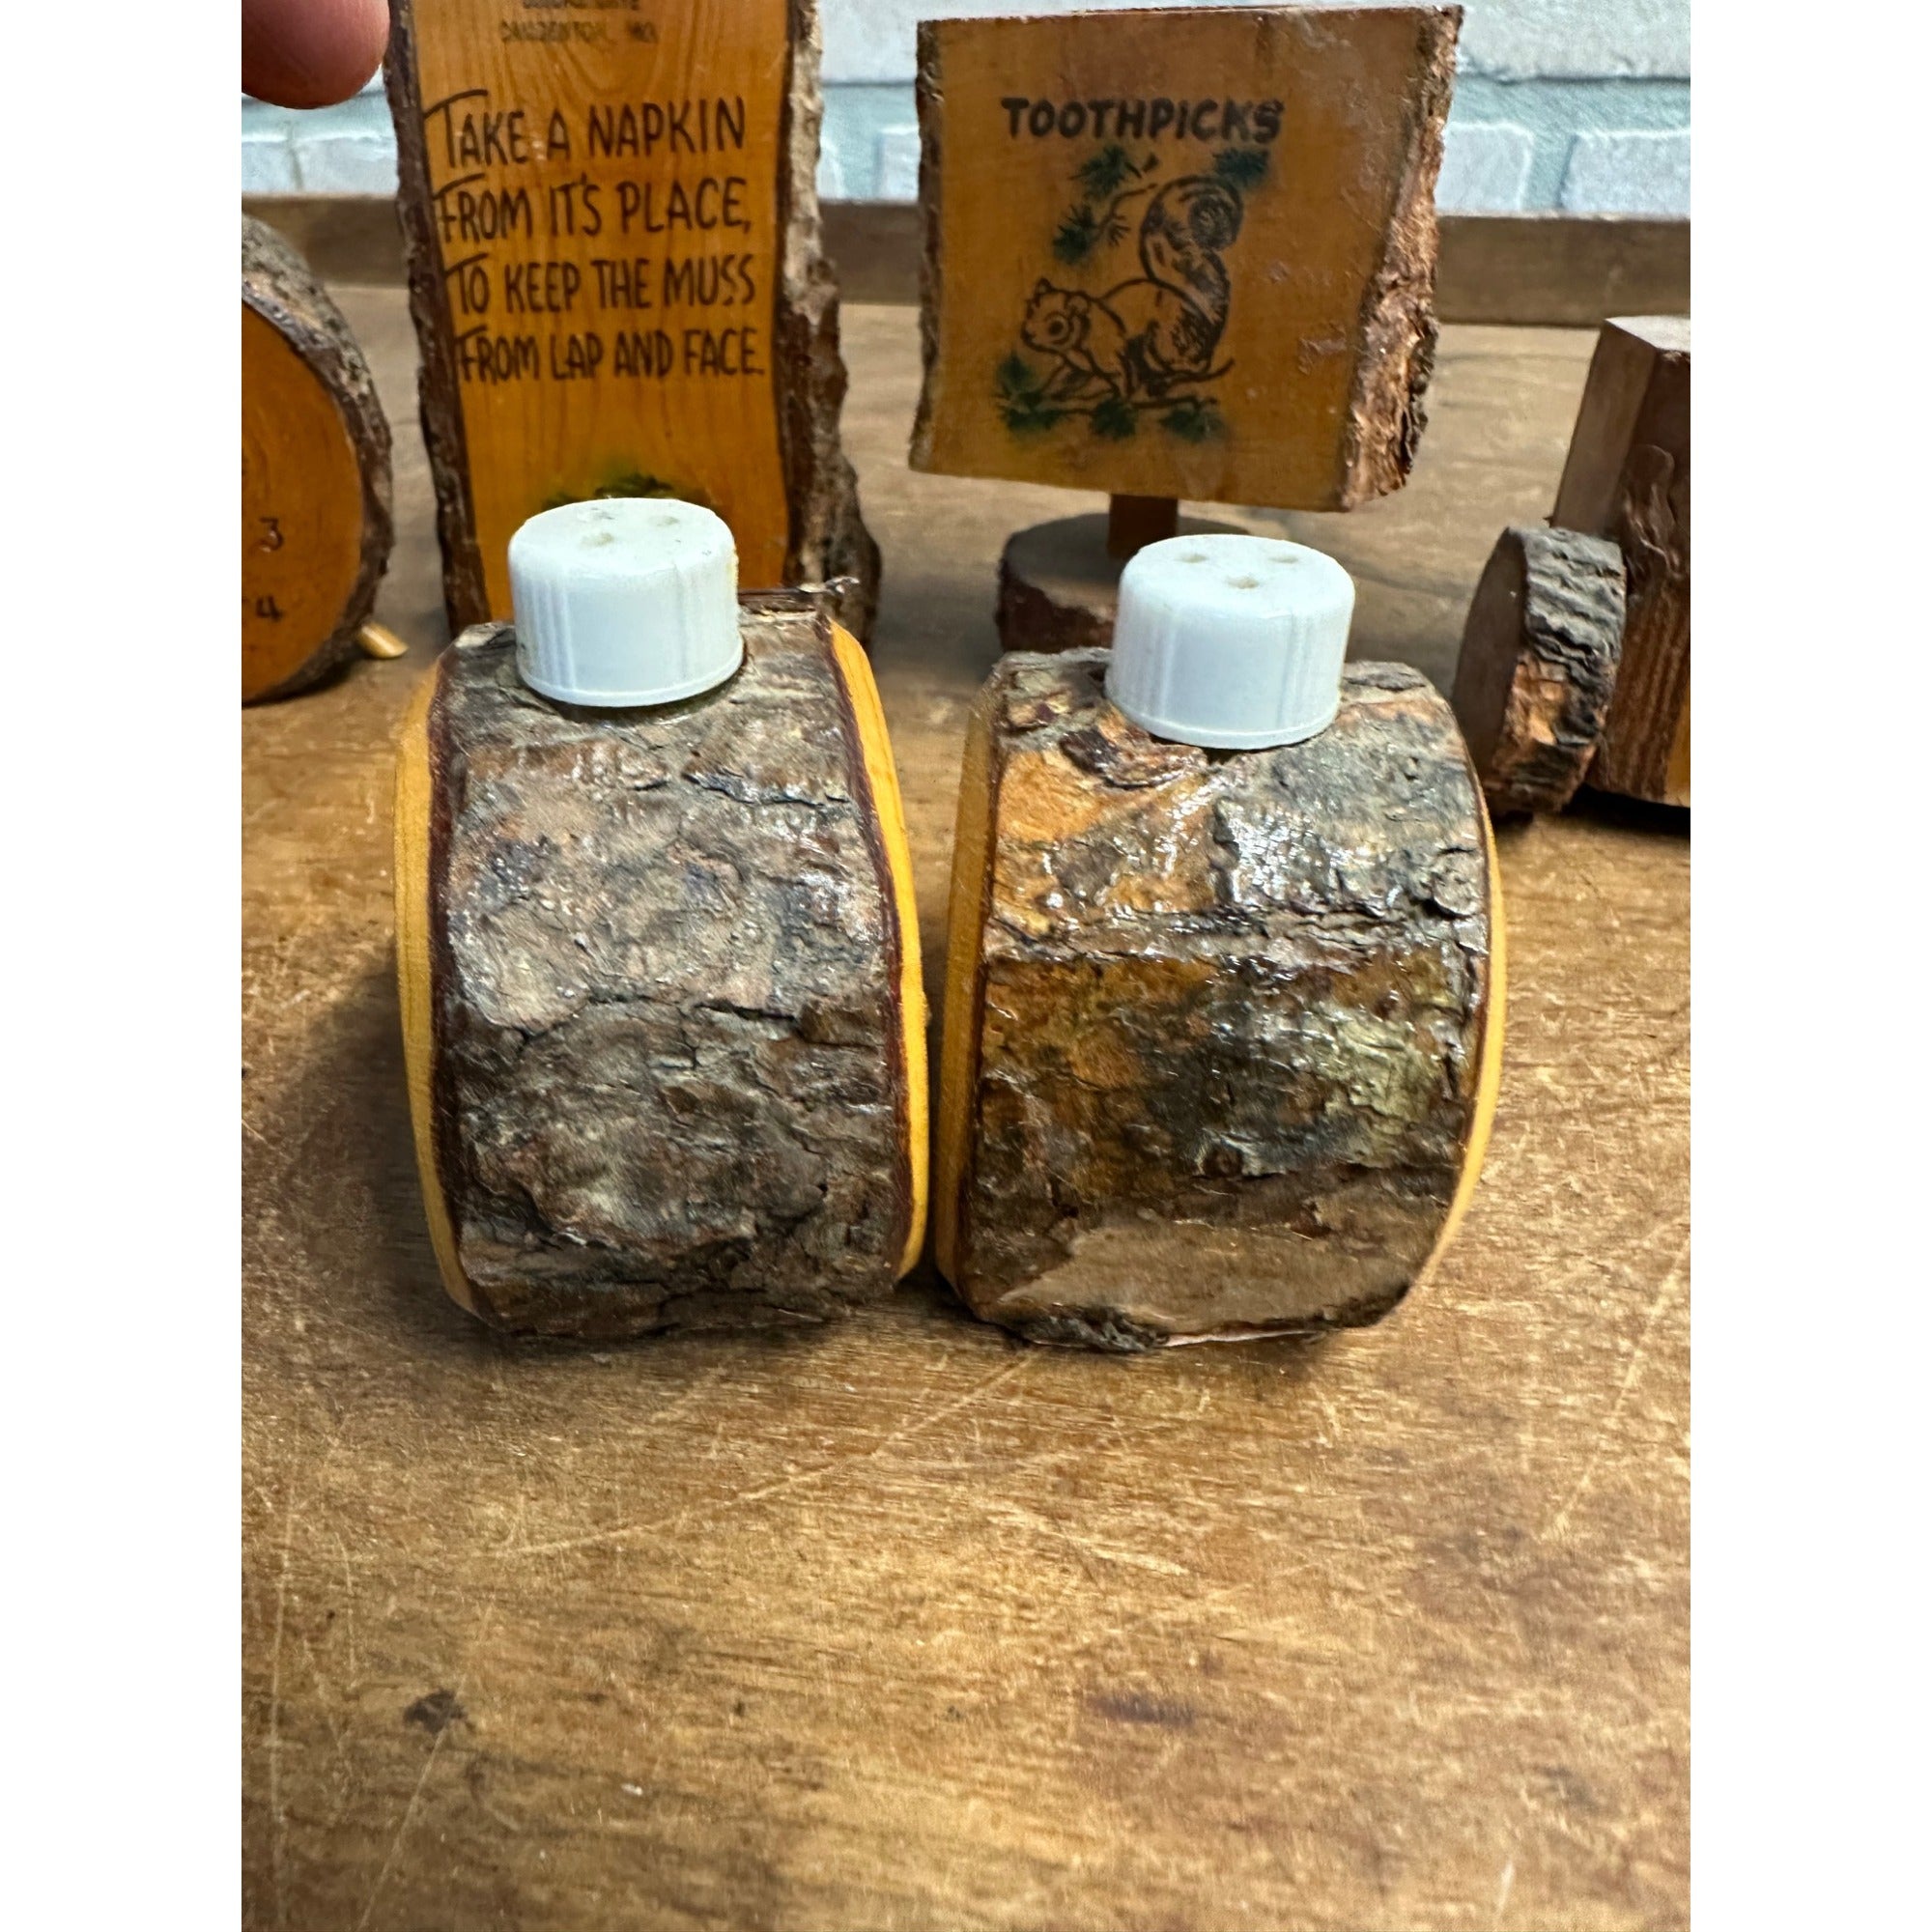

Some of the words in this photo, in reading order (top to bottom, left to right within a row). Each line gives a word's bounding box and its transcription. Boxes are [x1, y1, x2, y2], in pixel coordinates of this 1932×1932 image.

[424, 89, 528, 168] TAKE
[547, 108, 570, 160] A
[587, 96, 746, 158] NAPKIN
[1001, 97, 1285, 143] TOOTHPICKS
[433, 174, 533, 242] FROM
[550, 172, 602, 237] IT'S
[616, 177, 752, 235] PLACE,
[444, 253, 489, 315] TO
[504, 262, 580, 313] KEEP
[590, 257, 650, 309] THE
[664, 253, 756, 306] MUSS
[455, 327, 540, 384] FROM
[550, 334, 604, 381] LAP
[613, 328, 672, 379] AND
[249, 517, 284, 552] 3
[255, 595, 285, 622] 4
